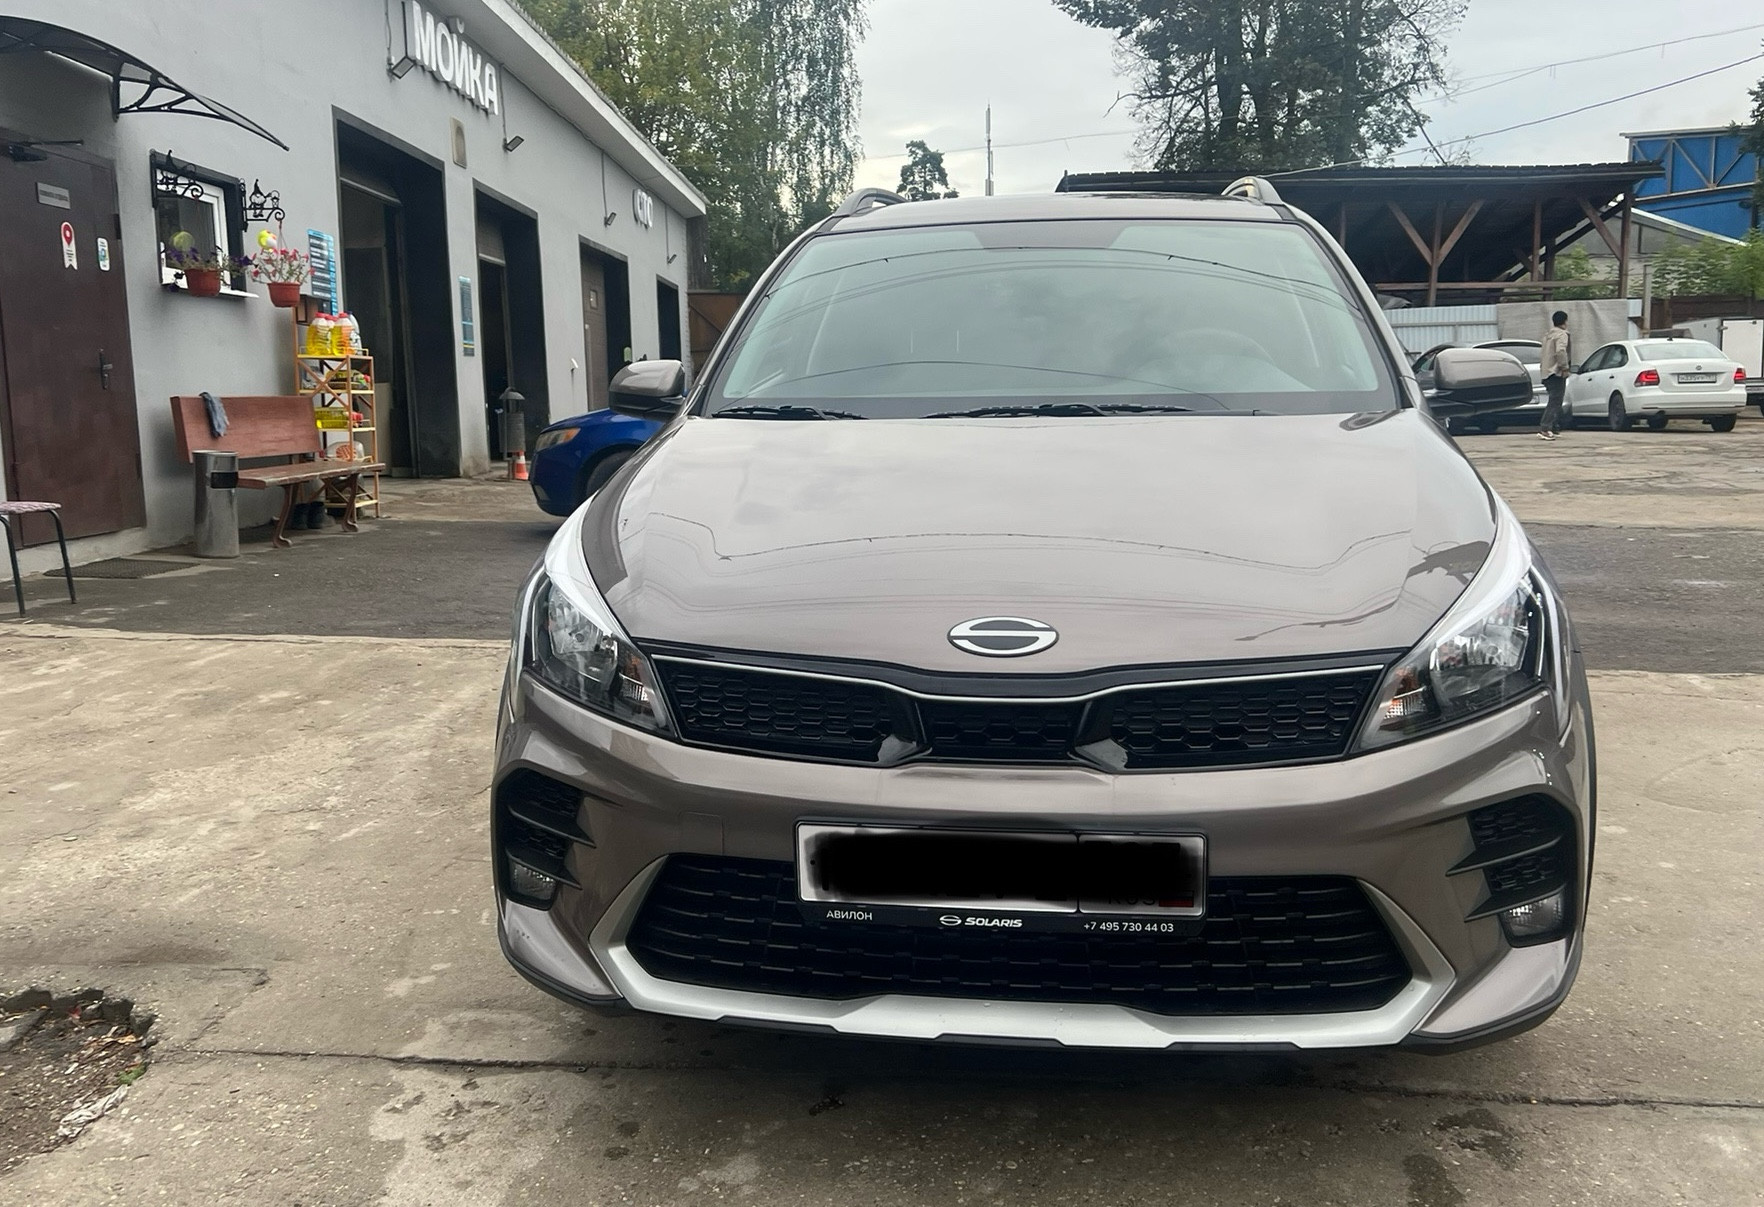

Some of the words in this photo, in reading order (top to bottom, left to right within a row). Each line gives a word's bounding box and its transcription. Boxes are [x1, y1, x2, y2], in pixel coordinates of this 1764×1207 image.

[413, 0, 498, 115] МОЙКА
[826, 910, 873, 921] АВИЛОН
[964, 917, 1022, 928] SOLARIS
[1083, 921, 1097, 931] +7
[1099, 922, 1120, 932] 495
[1122, 922, 1142, 932] 730
[1144, 923, 1158, 932] 44
[1160, 923, 1174, 932] 03
